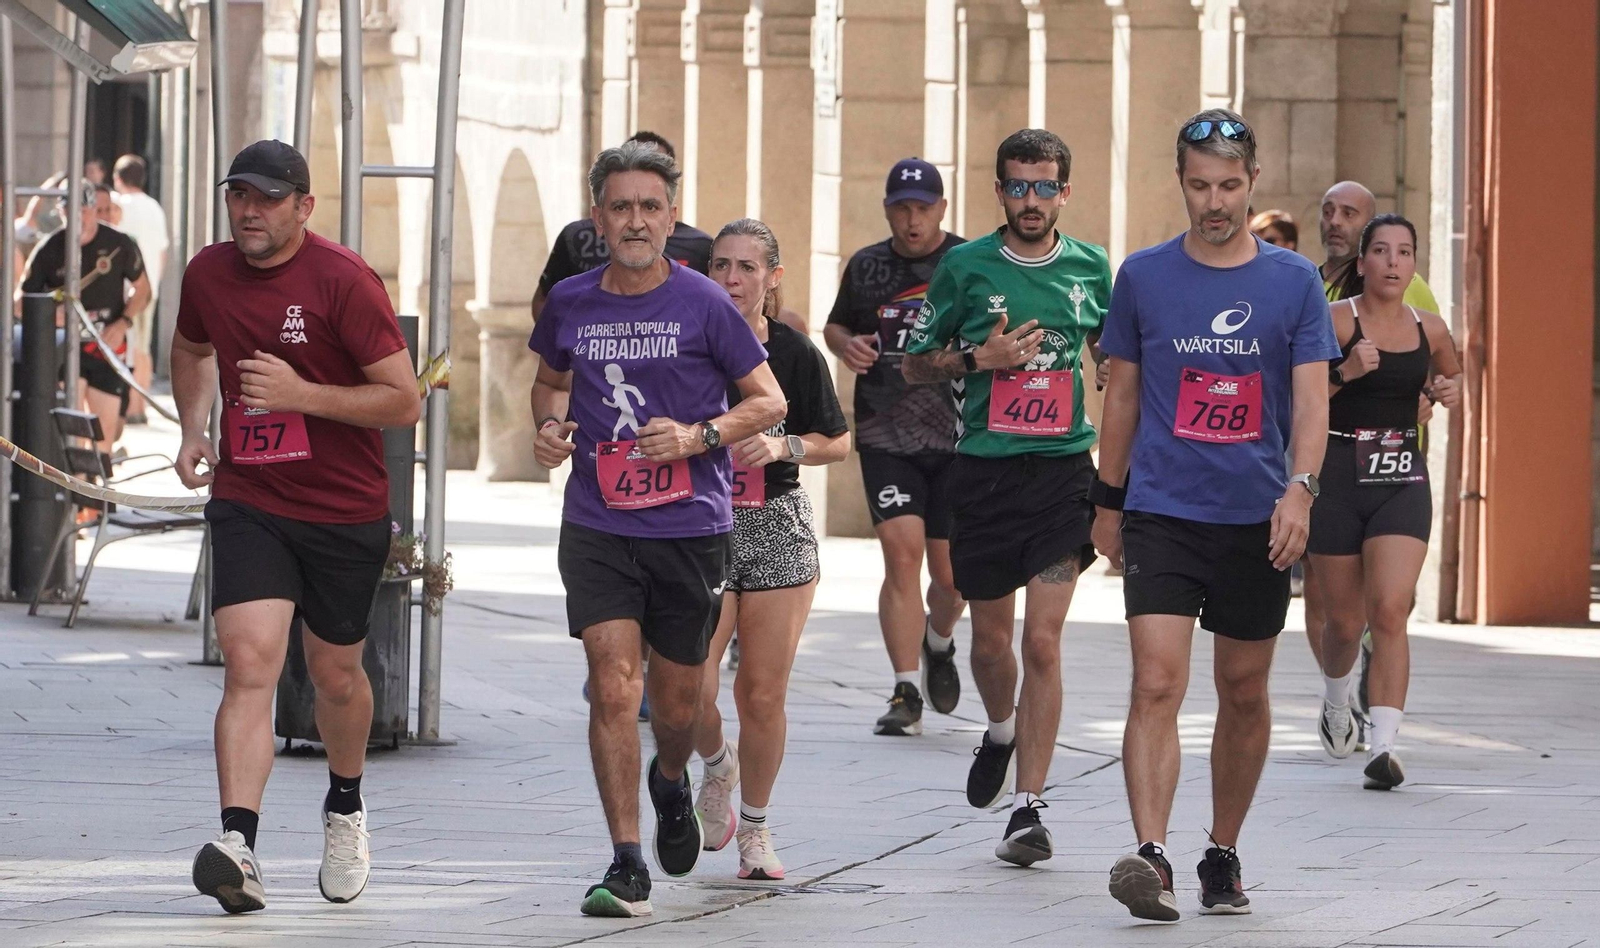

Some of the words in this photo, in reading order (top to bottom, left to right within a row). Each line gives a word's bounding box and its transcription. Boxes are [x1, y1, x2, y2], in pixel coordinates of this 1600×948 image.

[862, 256, 891, 285] 25
[286, 305, 302, 317] CE
[282, 318, 305, 330] AM
[577, 326, 583, 339] V
[584, 322, 632, 338] CARREIRA
[634, 321, 681, 335] POPULAR
[573, 341, 587, 355] de
[588, 336, 678, 360] RIBADAVIA
[1172, 336, 1261, 355] WÄRTSILÄ
[1215, 381, 1238, 392] CAE
[1003, 398, 1059, 423] 404
[1190, 400, 1249, 431] 768
[239, 422, 286, 452] 757
[1369, 451, 1413, 474] 158
[615, 463, 673, 497] 430
